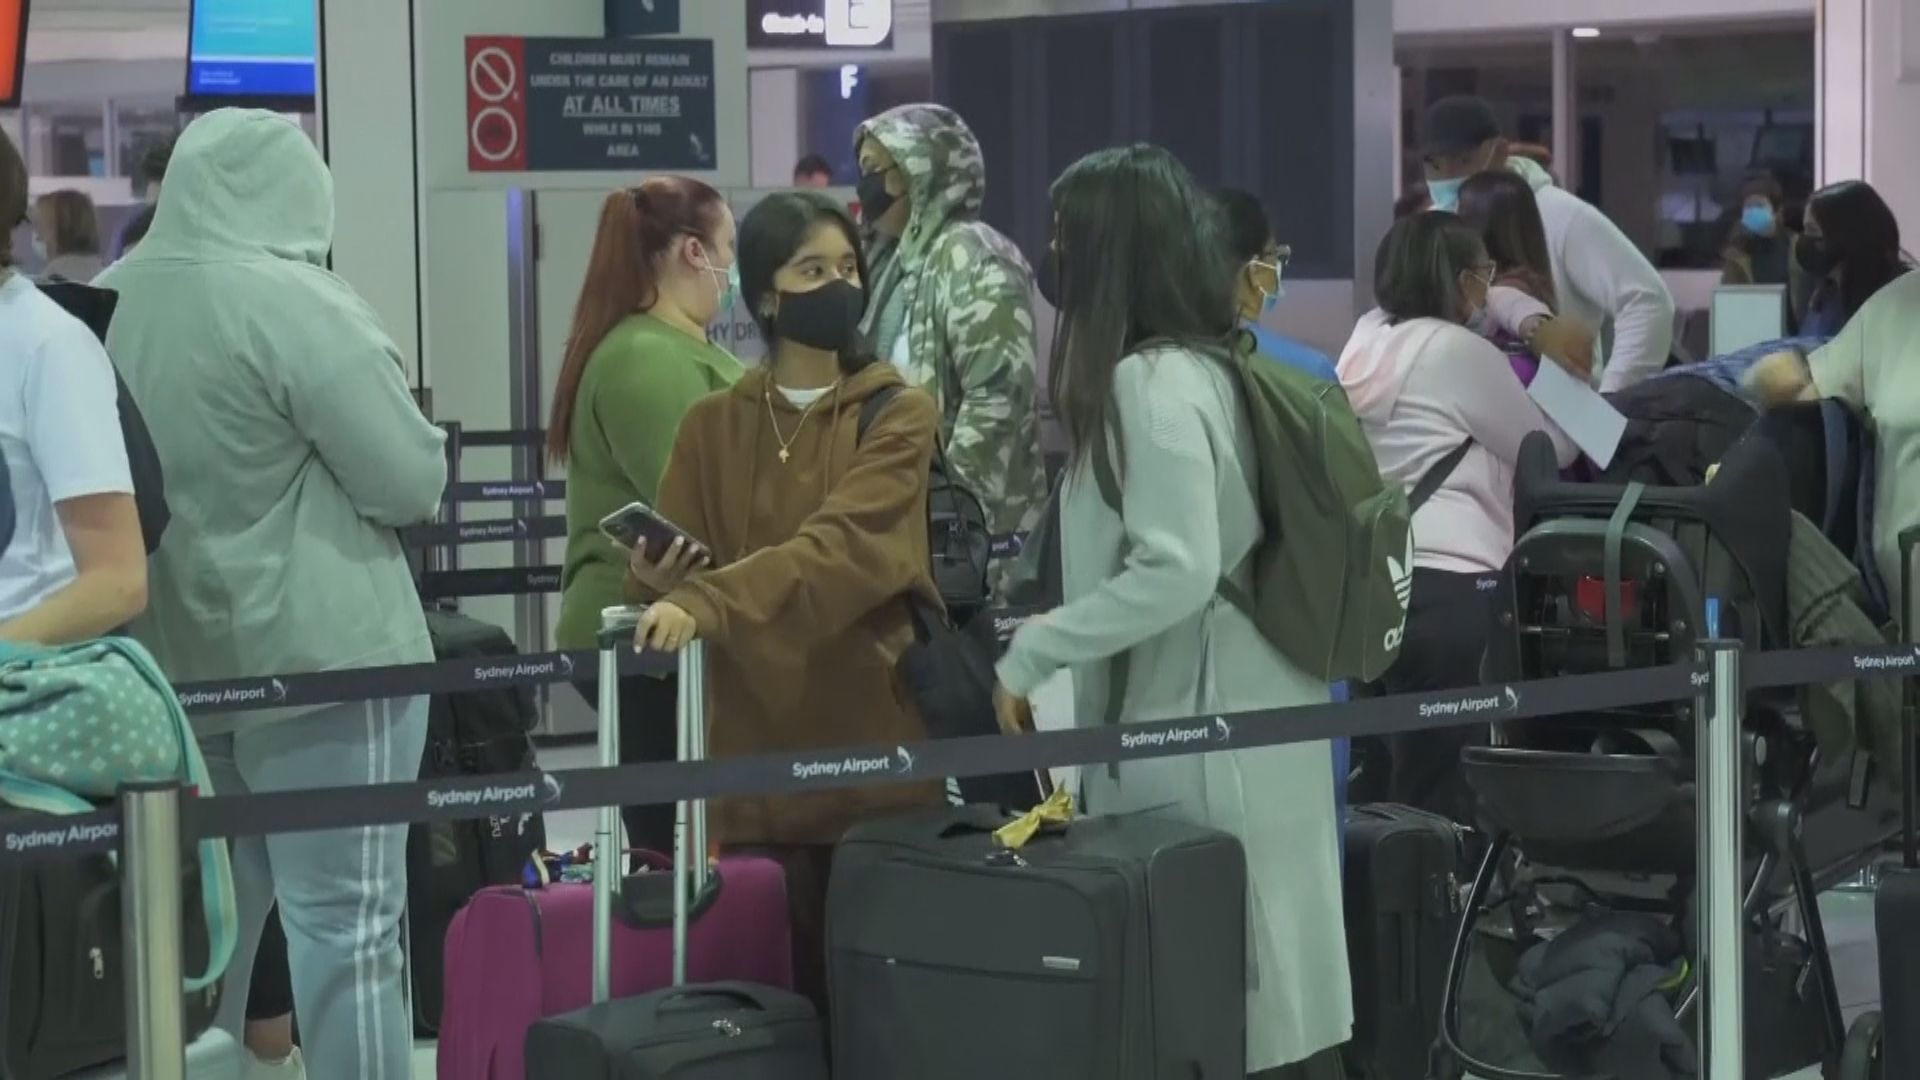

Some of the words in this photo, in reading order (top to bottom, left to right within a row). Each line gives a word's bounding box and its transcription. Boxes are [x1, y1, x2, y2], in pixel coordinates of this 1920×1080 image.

[549, 52, 607, 66] CHILDREN
[609, 53, 642, 66] MUST
[645, 53, 690, 67] REMAIN
[530, 74, 571, 88] UNDER
[573, 74, 596, 88] THE
[598, 74, 631, 88] CARE
[632, 75, 649, 88] OF
[651, 75, 669, 88] AN
[671, 75, 709, 88] ADULT
[841, 64, 858, 99] F
[562, 95, 586, 115] AT
[591, 95, 625, 115] ALL
[629, 95, 681, 115] TIMES
[582, 122, 618, 136] WHILE
[620, 122, 634, 136] IN
[635, 122, 662, 136] THIS
[606, 143, 640, 157] AREA
[482, 486, 508, 497] Sydney
[508, 484, 534, 495] Airport
[459, 525, 486, 538] Sydney
[487, 523, 514, 535] Airport
[1476, 578, 1498, 591] Sydn
[1853, 655, 1885, 669] Sydney
[1885, 654, 1915, 668] Airport
[474, 664, 516, 680] Sydney
[515, 661, 554, 676] Airport
[1690, 671, 1710, 687] Syd
[179, 690, 222, 706] Sydney
[223, 687, 265, 702] Airport
[1419, 701, 1461, 716] Sydney
[1461, 696, 1499, 712] Airport
[1121, 731, 1166, 748] Sydney
[1166, 725, 1209, 742] Airport
[792, 760, 843, 778] Sydney
[843, 755, 889, 774] Airport
[427, 789, 482, 807] Sydney
[482, 785, 535, 801] Airport
[5, 829, 66, 852] Sydney
[67, 823, 119, 842] Airpor
